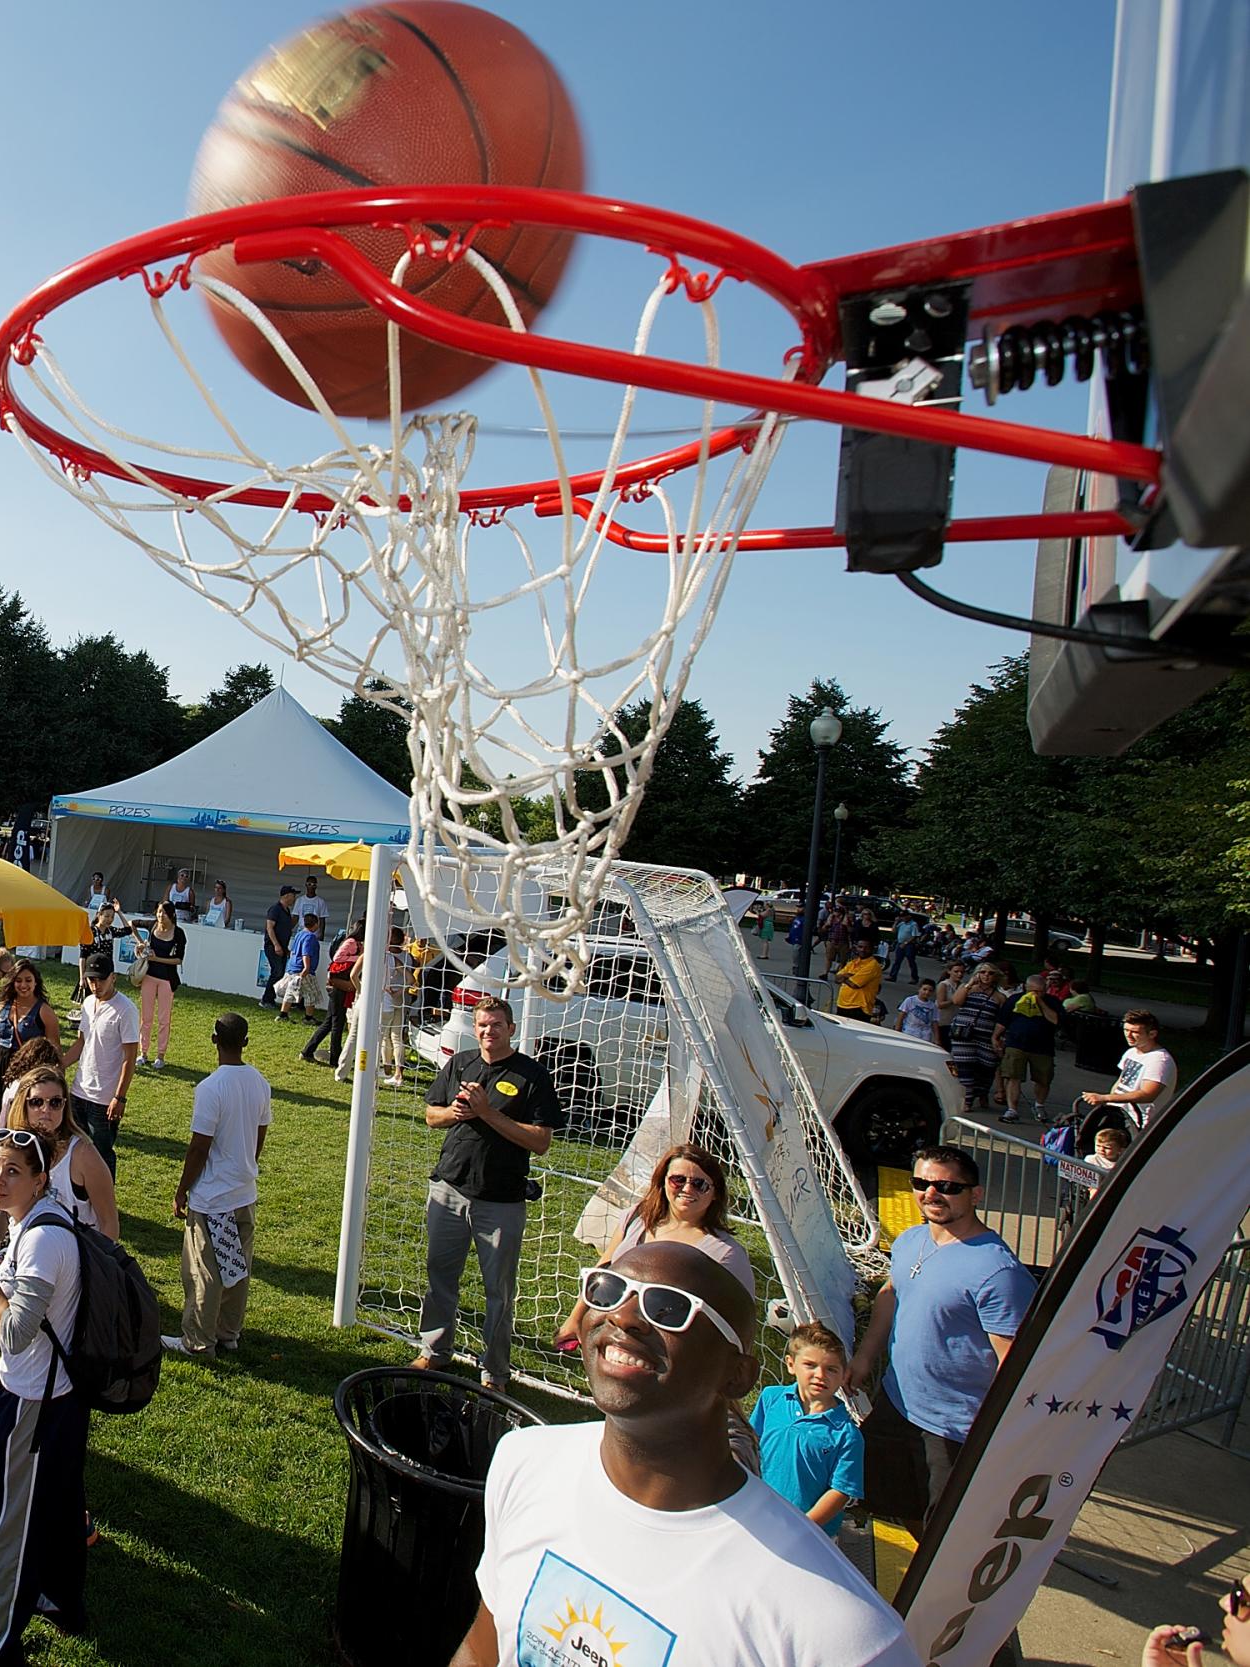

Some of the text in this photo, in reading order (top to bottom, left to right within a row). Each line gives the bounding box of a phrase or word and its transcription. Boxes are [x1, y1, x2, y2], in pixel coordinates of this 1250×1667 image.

[109, 805, 151, 818] PRIZES
[288, 821, 340, 837] PRIZES
[1060, 1161, 1097, 1181] NATIONAL
[526, 1631, 547, 1648] 2014
[571, 1636, 608, 1667] Jeep
